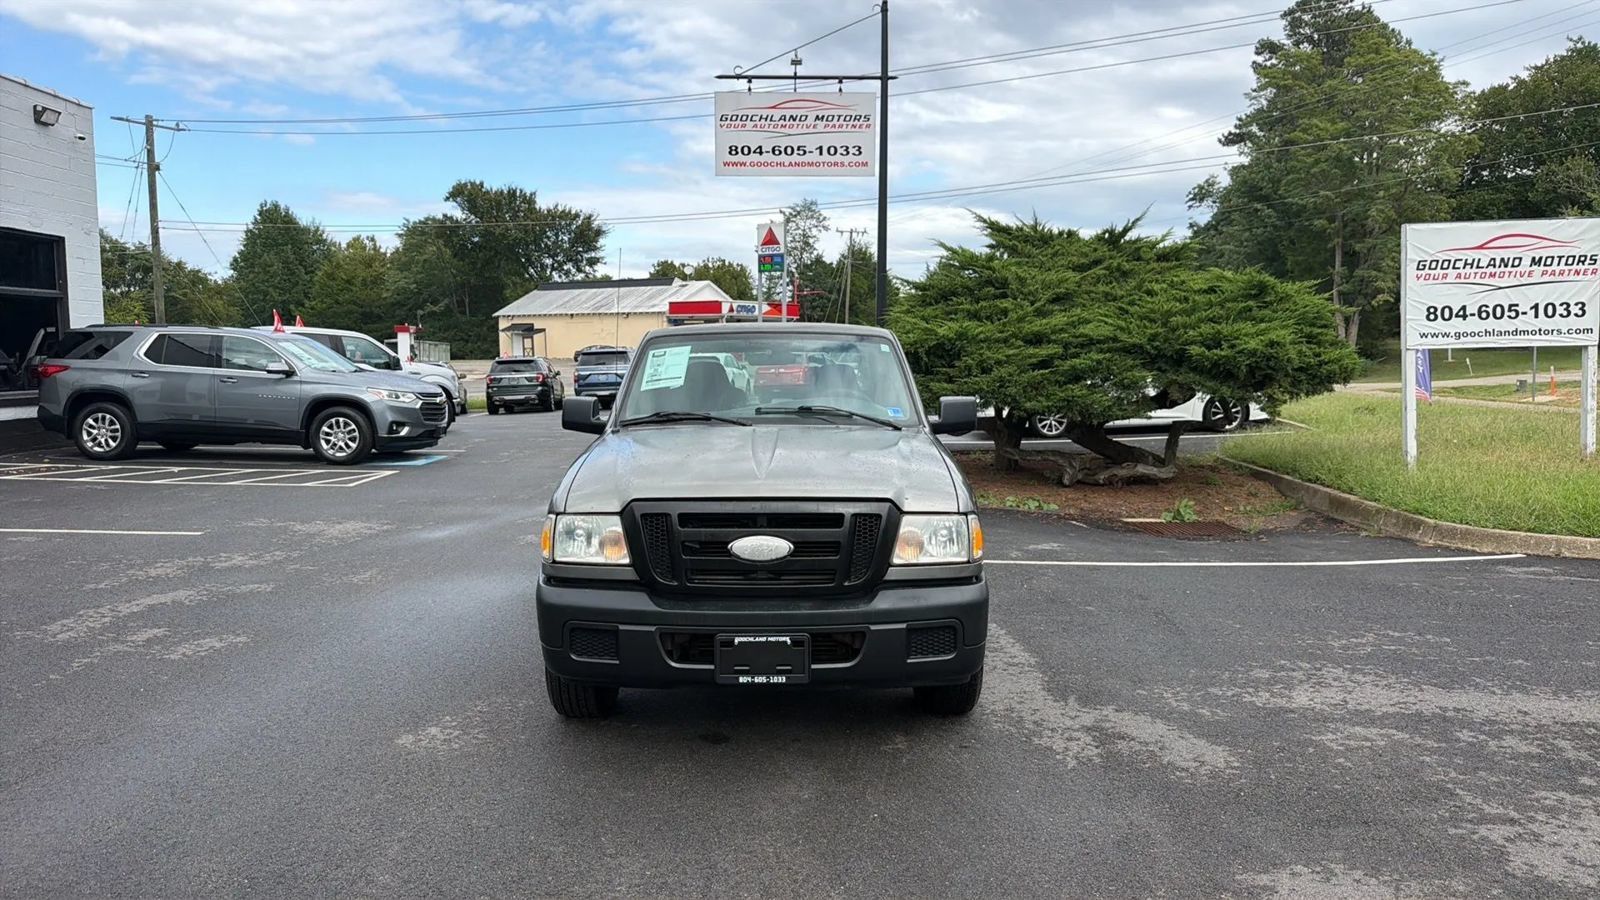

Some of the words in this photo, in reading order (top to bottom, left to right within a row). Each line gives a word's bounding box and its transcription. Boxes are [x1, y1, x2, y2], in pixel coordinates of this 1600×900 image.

[720, 114, 808, 122] GOOCHLAND
[814, 114, 871, 122] MOTORS
[728, 145, 863, 156] 804-605-1033
[1416, 256, 1523, 271] GOOCHLAND
[1529, 254, 1599, 268] MOTORS
[1415, 273, 1449, 281] YOUR
[1454, 269, 1535, 280] AUTOMOTIVE
[1541, 268, 1599, 278] PARTNER
[736, 305, 756, 314] CITGO
[1425, 301, 1587, 322] 804-605-1033
[1418, 326, 1594, 340] www.goochlandmotors.com
